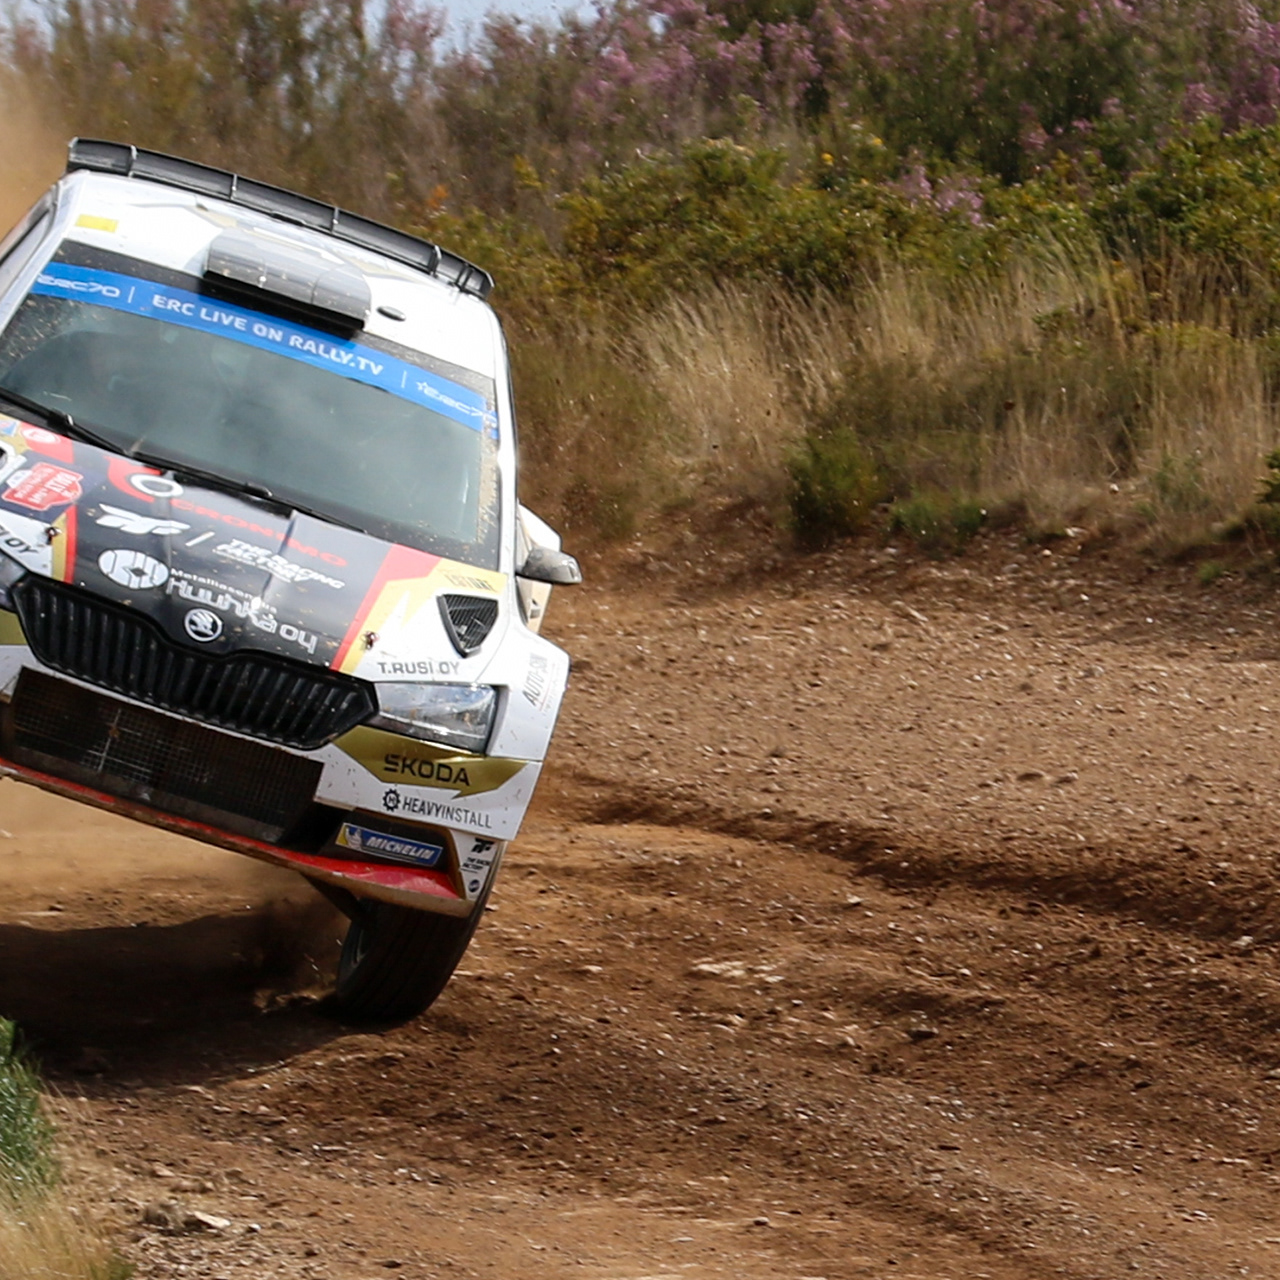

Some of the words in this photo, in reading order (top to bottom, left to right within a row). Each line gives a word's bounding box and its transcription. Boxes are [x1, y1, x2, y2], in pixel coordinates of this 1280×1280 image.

[152, 294, 195, 316] ERC
[200, 307, 247, 331] LIVE
[253, 322, 283, 342] ON
[289, 334, 384, 376] RALLY.TV
[5, 537, 39, 555] OY
[170, 499, 348, 567] CRONIMO
[214, 544, 311, 583] FACTORY
[231, 538, 272, 558] THE
[270, 552, 345, 589] RACING
[171, 568, 277, 614] Metalliasenus
[439, 662, 460, 675] OY
[403, 796, 492, 829] HEAVYINSTALL
[366, 836, 435, 860] MICHELIN
